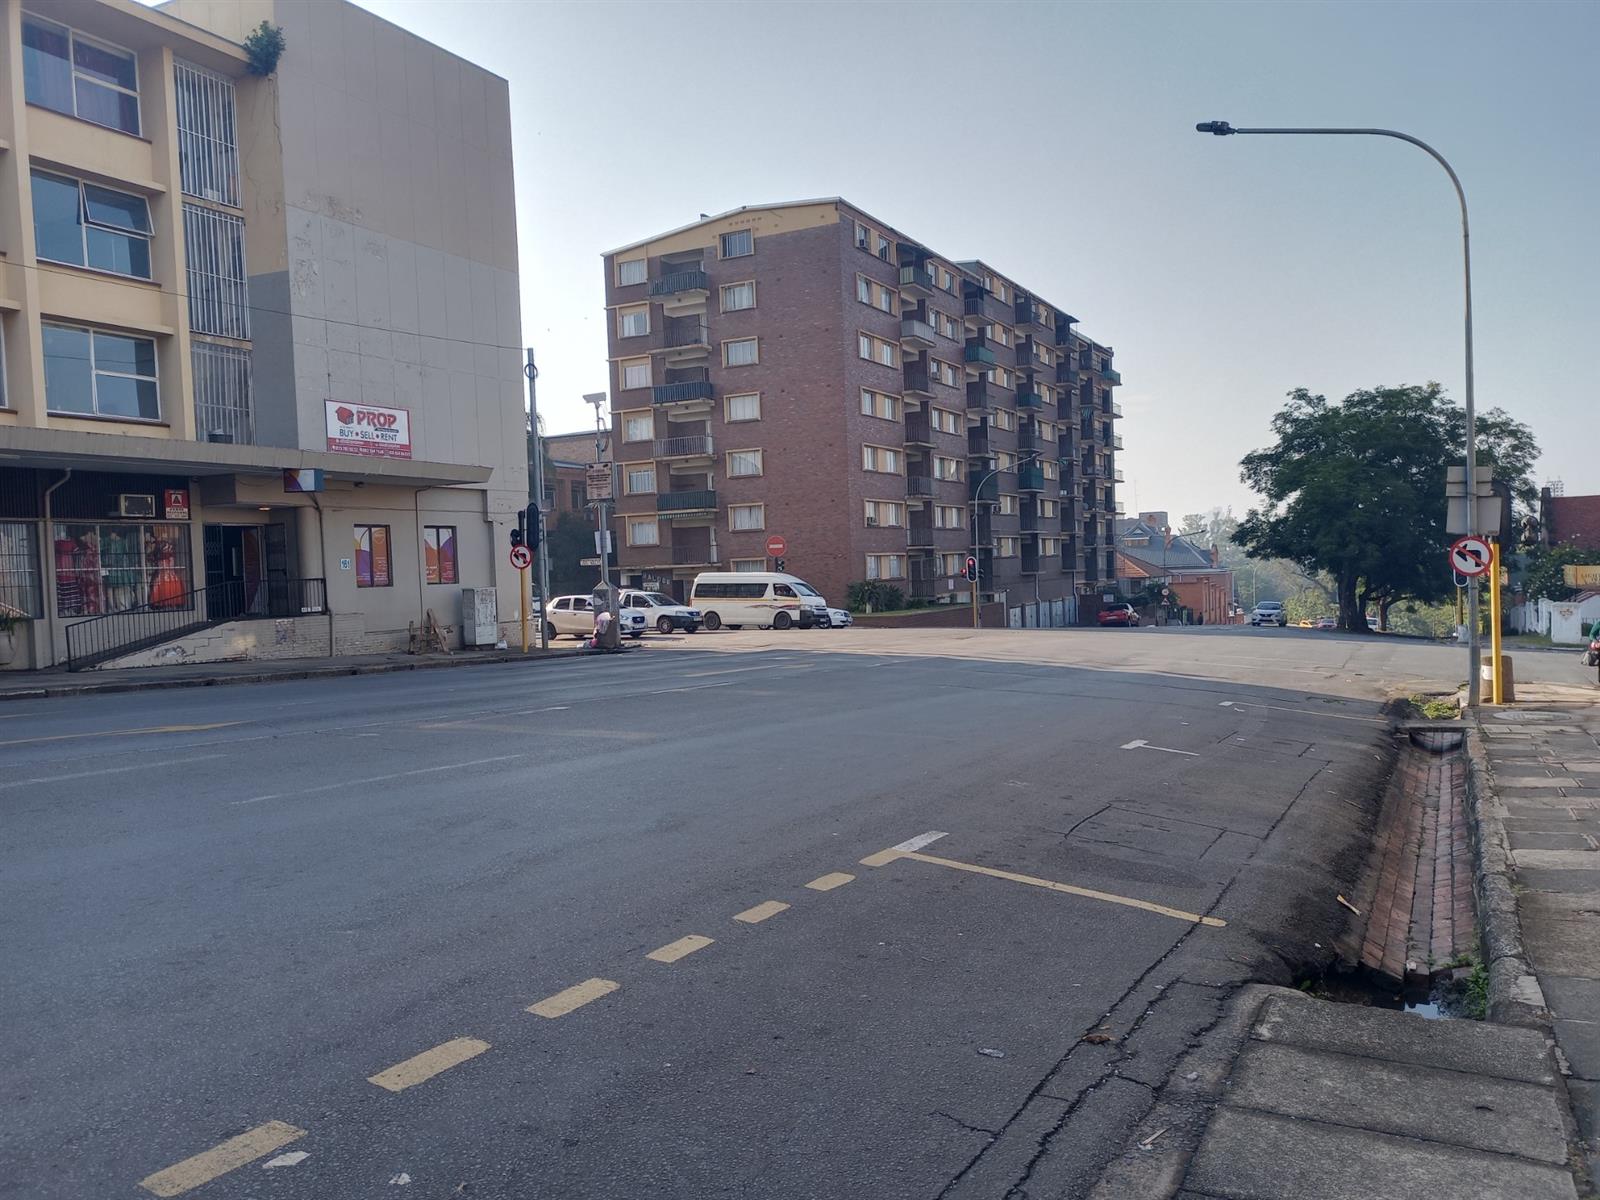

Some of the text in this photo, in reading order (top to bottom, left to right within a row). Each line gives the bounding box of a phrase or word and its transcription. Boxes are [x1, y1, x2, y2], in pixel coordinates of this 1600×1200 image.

[356, 410, 397, 428] PROP
[339, 429, 354, 438] BUY
[360, 430, 375, 440] SELL
[380, 432, 398, 442] RENT
